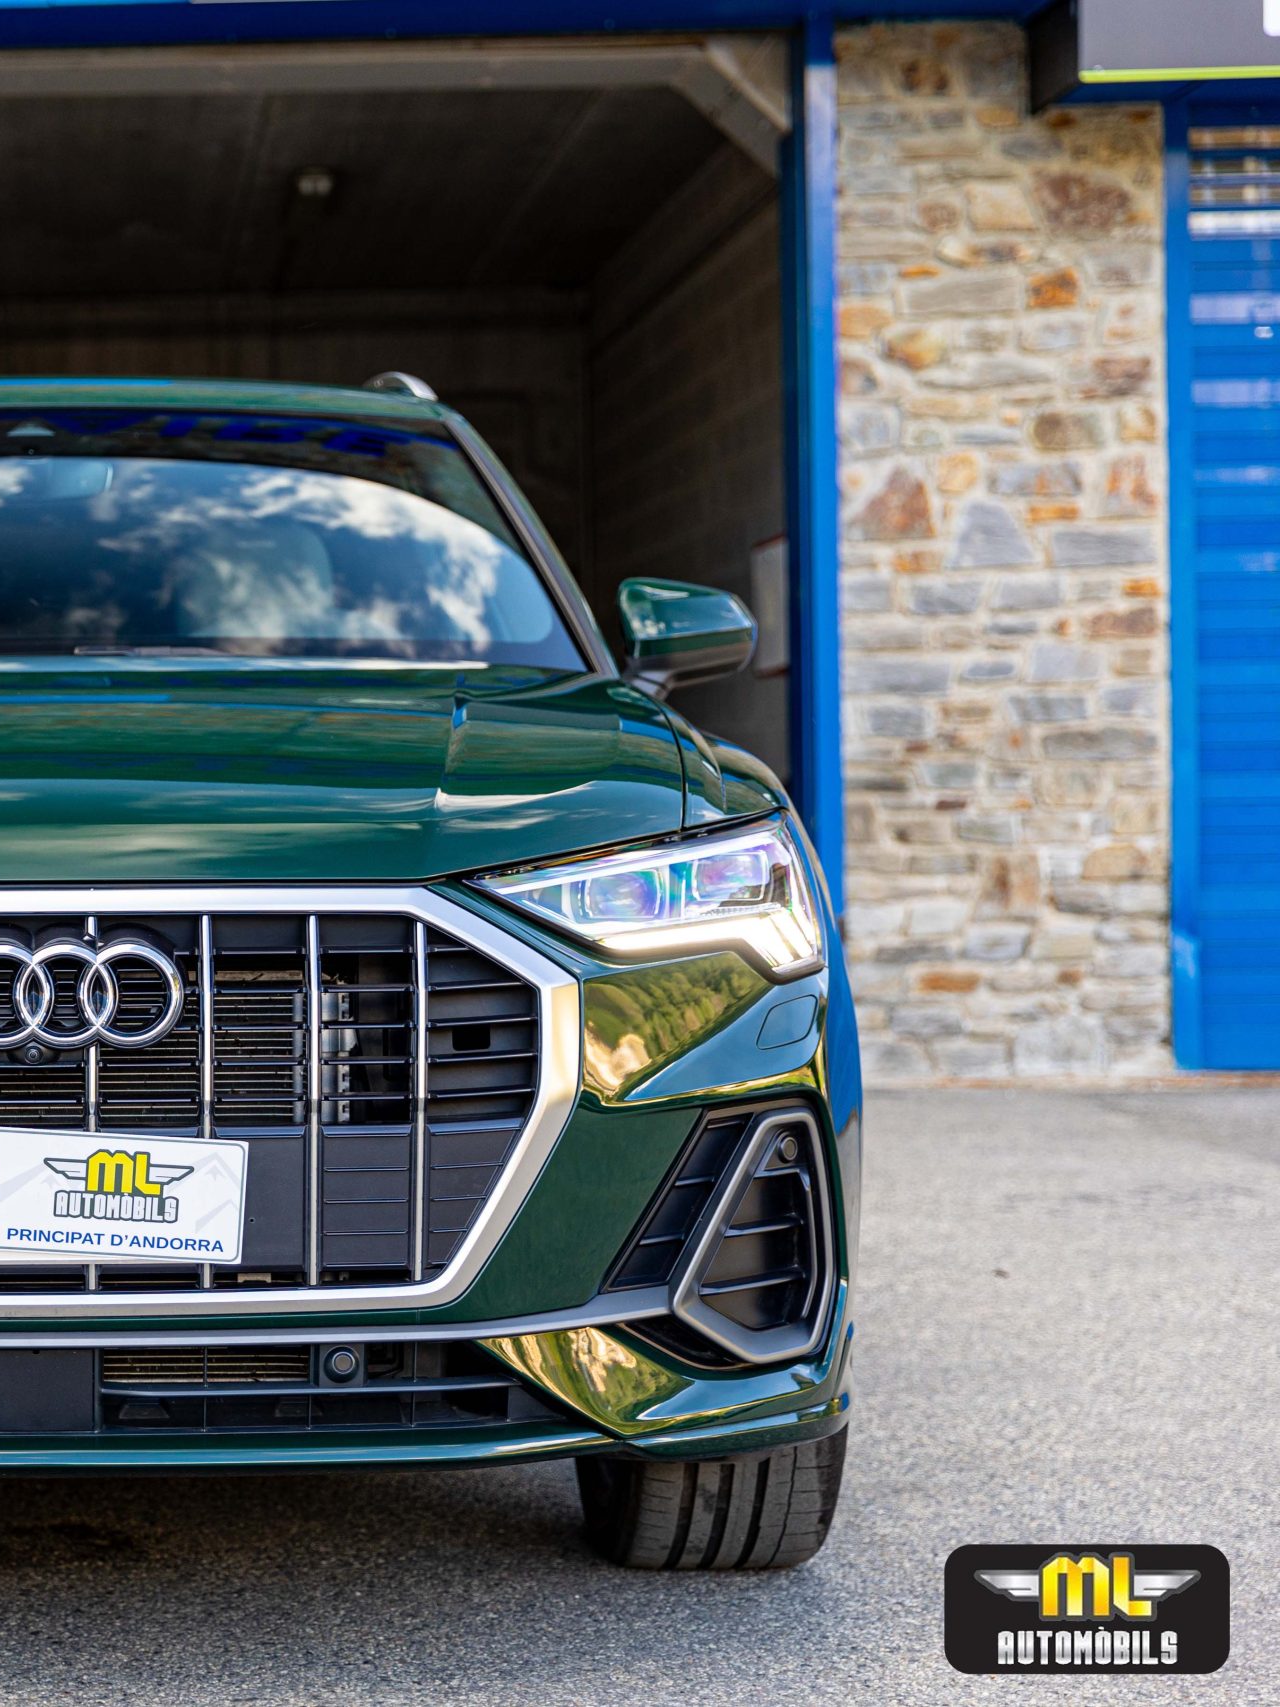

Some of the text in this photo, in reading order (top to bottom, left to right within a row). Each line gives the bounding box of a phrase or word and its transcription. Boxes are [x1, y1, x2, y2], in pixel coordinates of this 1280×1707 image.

[86, 1150, 162, 1196] ML
[7, 1228, 224, 1252] PRINCIPAT D’ANDORRA
